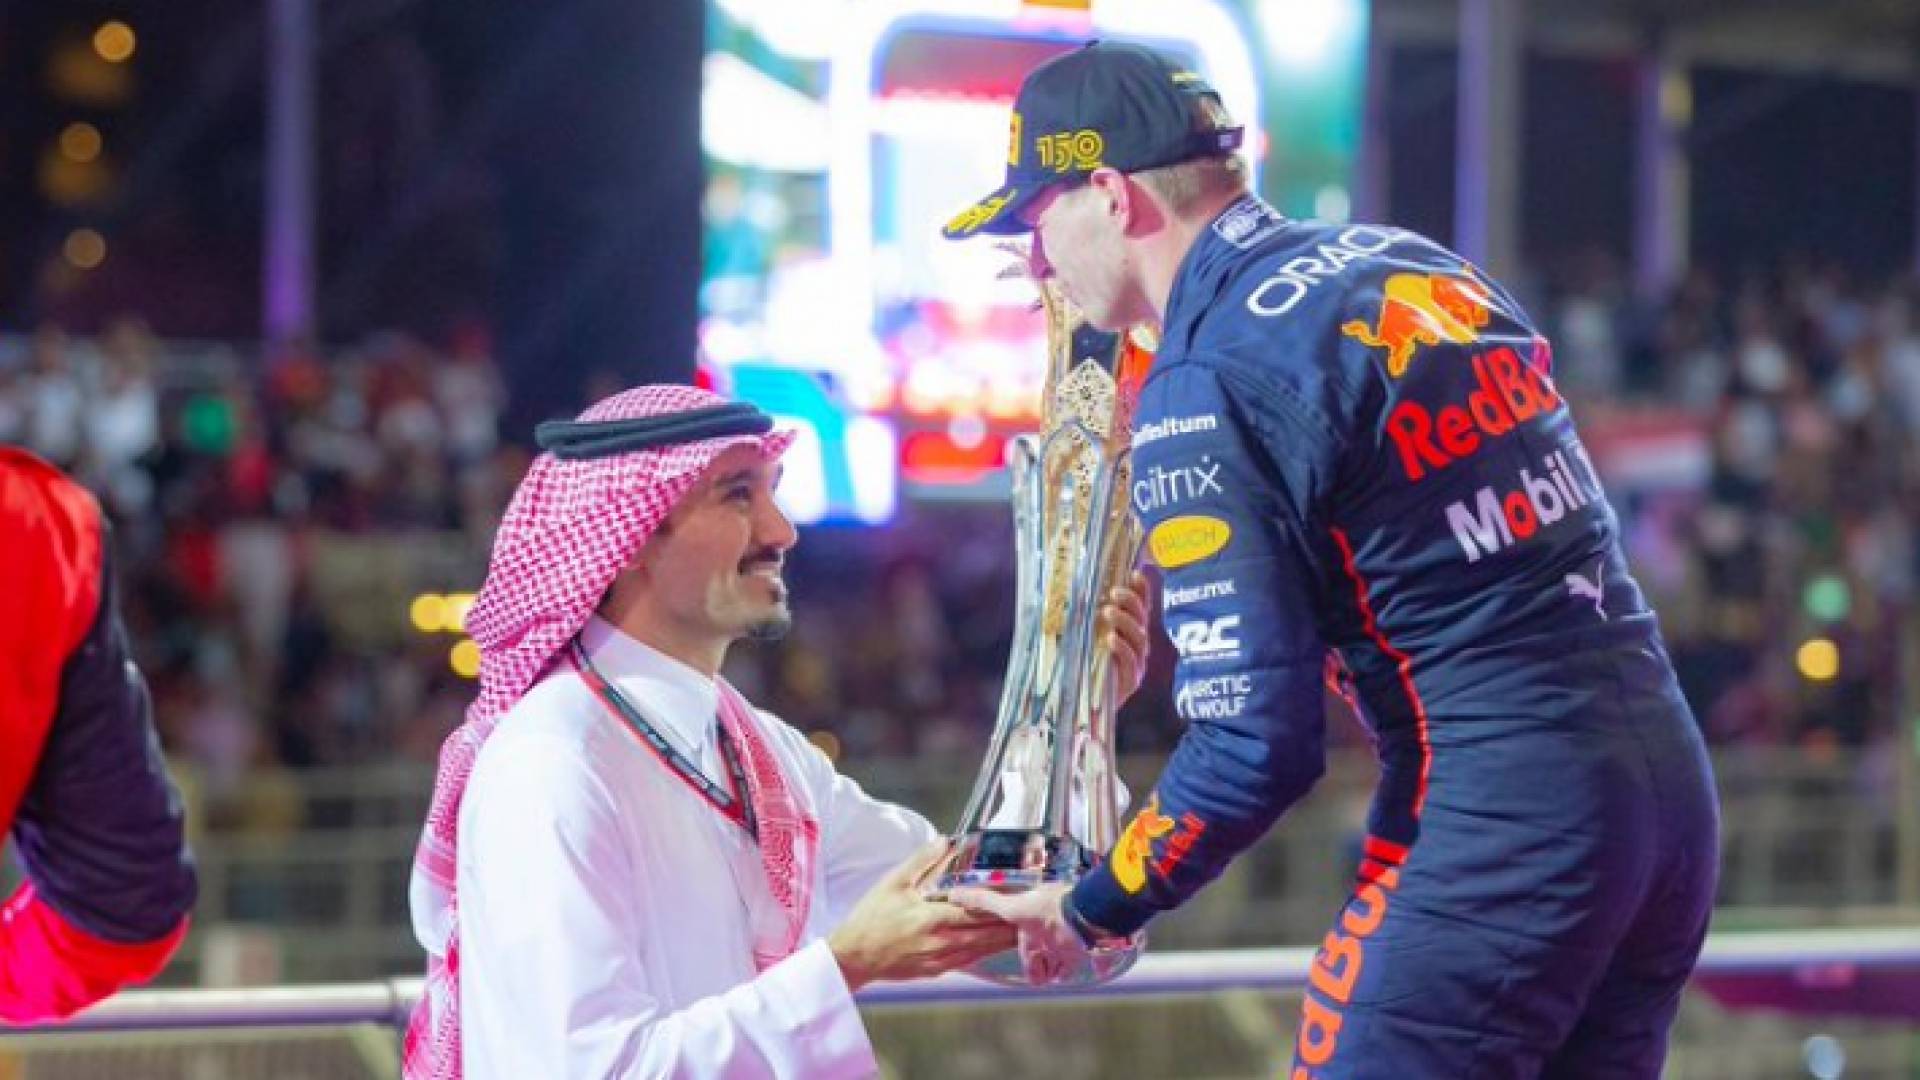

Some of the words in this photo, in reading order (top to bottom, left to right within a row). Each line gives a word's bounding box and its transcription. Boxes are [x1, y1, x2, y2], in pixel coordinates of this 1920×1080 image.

[1036, 129, 1103, 173] 150
[1133, 454, 1224, 511] citrix
[1445, 449, 1586, 562] Mobil
[1195, 695, 1246, 719] WOLF
